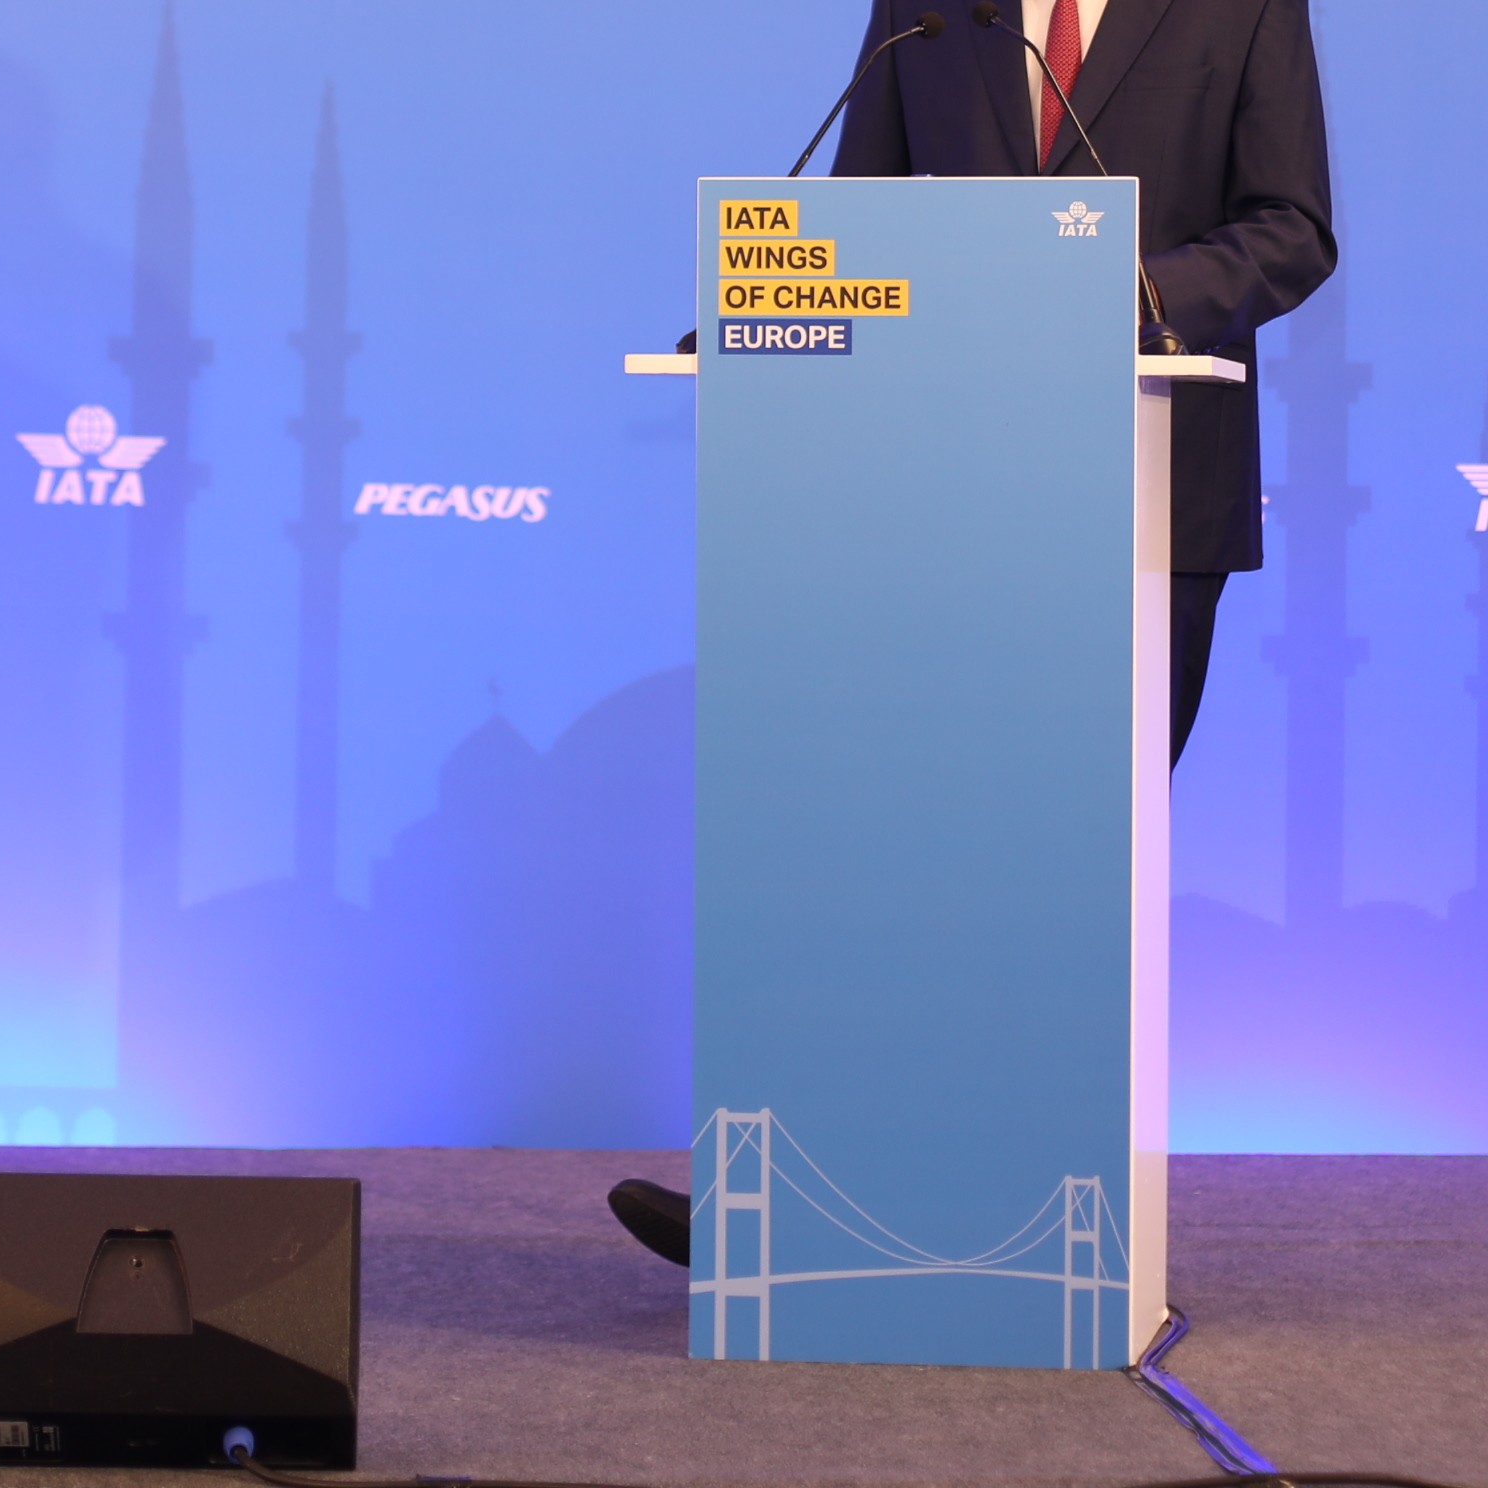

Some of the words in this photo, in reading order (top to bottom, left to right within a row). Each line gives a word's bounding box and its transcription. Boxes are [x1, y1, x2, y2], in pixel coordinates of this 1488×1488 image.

[727, 208, 789, 229] IATA
[1059, 224, 1097, 236] IATA
[726, 247, 827, 269] WINGS
[726, 286, 764, 308] OF
[774, 286, 900, 309] CHANGE
[725, 325, 845, 348] EUROPE
[35, 468, 144, 506] IATA
[355, 484, 549, 522] PEGASUS
